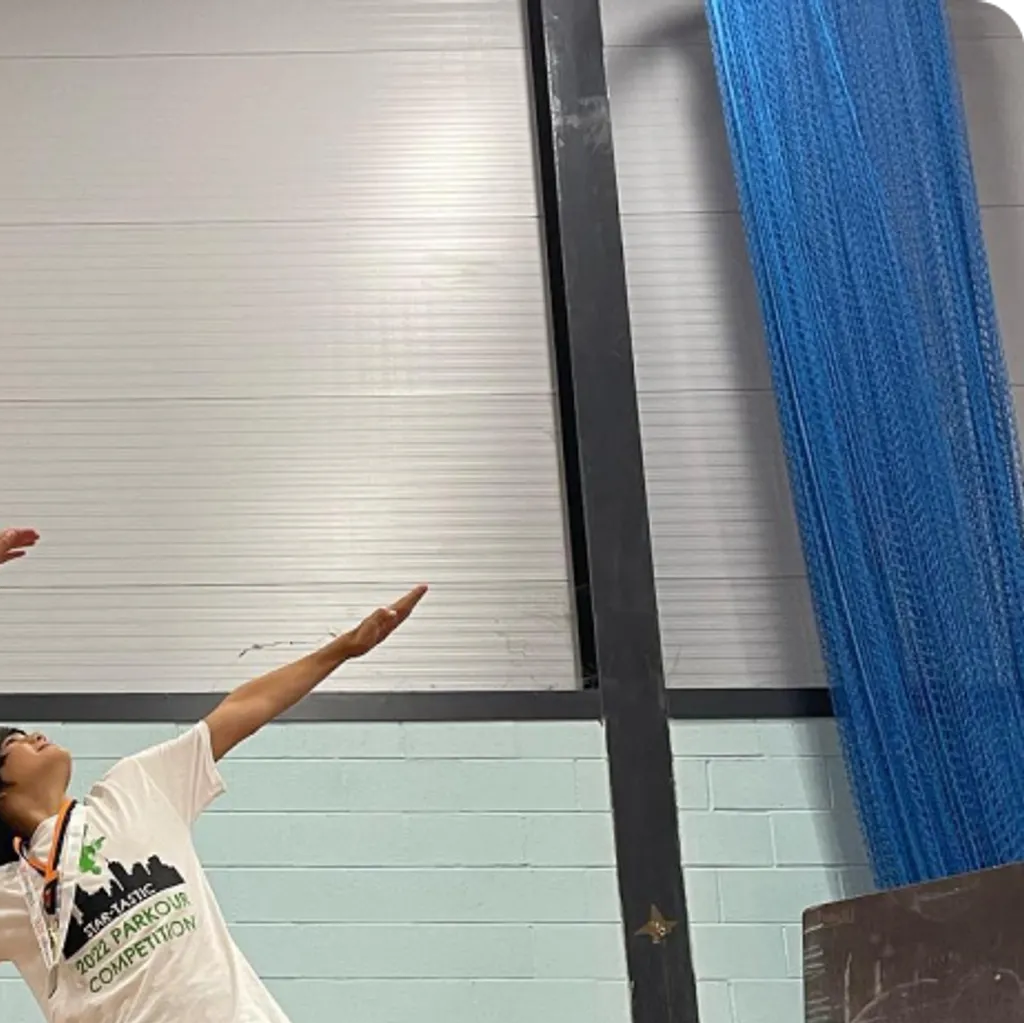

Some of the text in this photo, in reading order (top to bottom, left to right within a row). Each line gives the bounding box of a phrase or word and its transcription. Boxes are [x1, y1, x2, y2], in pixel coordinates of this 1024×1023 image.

[76, 891, 191, 975] 2022 PARKOUR
[83, 882, 156, 938] STAR-TASTIC
[89, 915, 196, 993] COMPETITION
